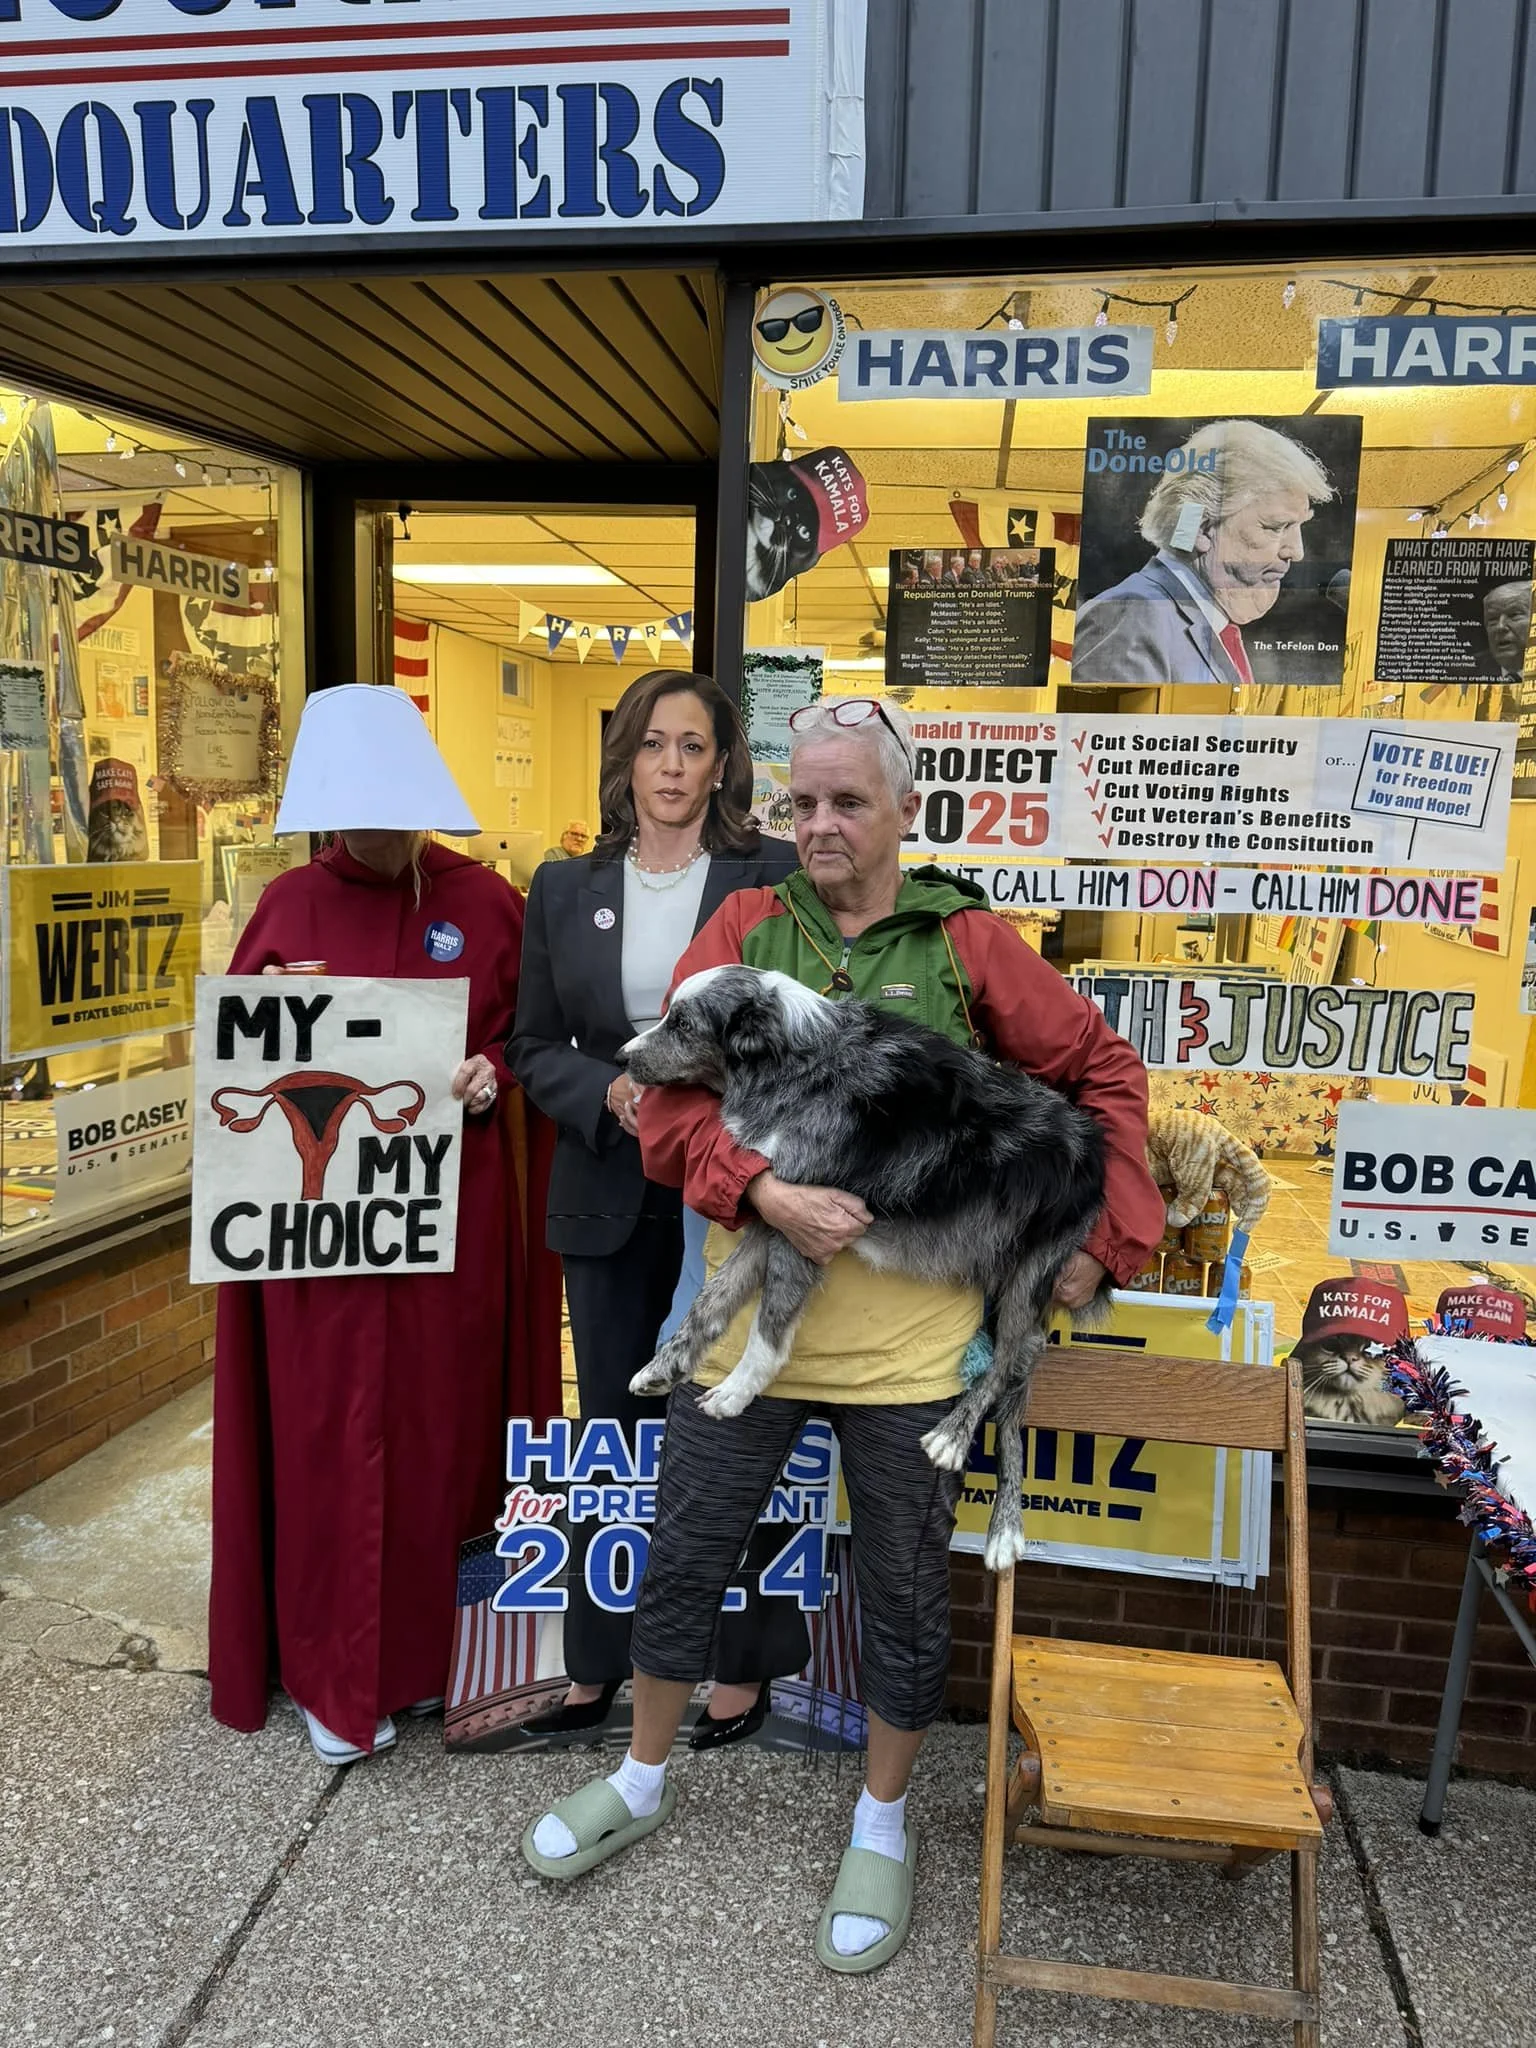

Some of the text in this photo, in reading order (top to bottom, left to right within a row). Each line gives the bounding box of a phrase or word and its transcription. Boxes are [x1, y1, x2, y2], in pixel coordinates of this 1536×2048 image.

[790, 372, 823, 389] SMILE
[838, 328, 846, 340] ON
[857, 333, 1131, 387] HARRIS
[1104, 428, 1147, 450] The
[1087, 447, 1217, 474] DoneOld
[814, 460, 850, 533] KAMALA
[831, 456, 862, 524] KATS FOR
[1394, 541, 1530, 558] WHAT CHILDREN HAVE
[120, 540, 241, 599] HARRIS
[1386, 560, 1532, 577] LEARNED FROM TRUMP:
[904, 590, 956, 600] Republicans
[970, 590, 1002, 598] Donald
[1004, 590, 1035, 599] Trump:
[1254, 640, 1339, 652] The TeFelon Don
[910, 721, 1056, 742] nald Trump's
[1090, 734, 1298, 756] Cut Social Security
[914, 748, 1058, 784] ROJECT
[1098, 758, 1240, 777] Cut Medicare
[1325, 756, 1356, 767] or...
[1372, 741, 1425, 768] VOTE
[1428, 750, 1490, 777] BLUE!
[1104, 782, 1290, 804] Cut Voting Rights
[1375, 768, 1473, 796] for Freedom
[1368, 789, 1472, 816] Joy and Hope!
[900, 790, 1050, 847] 025
[1111, 806, 1352, 829] Cut Veteran's Benefits
[1118, 830, 1374, 854] Destroy the Consitution
[96, 888, 130, 910] JIM
[992, 868, 1065, 903] CALL
[1078, 870, 1130, 908] HIM
[1139, 868, 1217, 909] DON
[1252, 874, 1314, 910] CALL
[1318, 876, 1360, 914] HIM
[1368, 877, 1479, 921] DONE
[430, 929, 459, 948] HARRIS
[34, 912, 185, 1007] WERTZ
[72, 1002, 152, 1024] STATE SENATE
[217, 994, 334, 1062] MY
[1208, 981, 1476, 1082] JUSTICE
[68, 1118, 116, 1152] BOB
[120, 1098, 188, 1136] CASEY
[68, 1157, 101, 1176] U.S.
[128, 1130, 189, 1157] SENATE
[357, 1134, 453, 1196] MY
[1342, 1150, 1454, 1196] BOB
[210, 1198, 442, 1272] CHOICE
[1338, 1218, 1417, 1243] U.S.
[1322, 1291, 1392, 1310] KATS FOR
[1446, 1295, 1514, 1312] MAKE CATS
[1318, 1305, 1391, 1326] KAMALA
[1476, 1309, 1512, 1325] AGAIN
[499, 1488, 563, 1529] for
[1020, 1494, 1102, 1518] SENATE
[491, 1522, 838, 1614] 204
